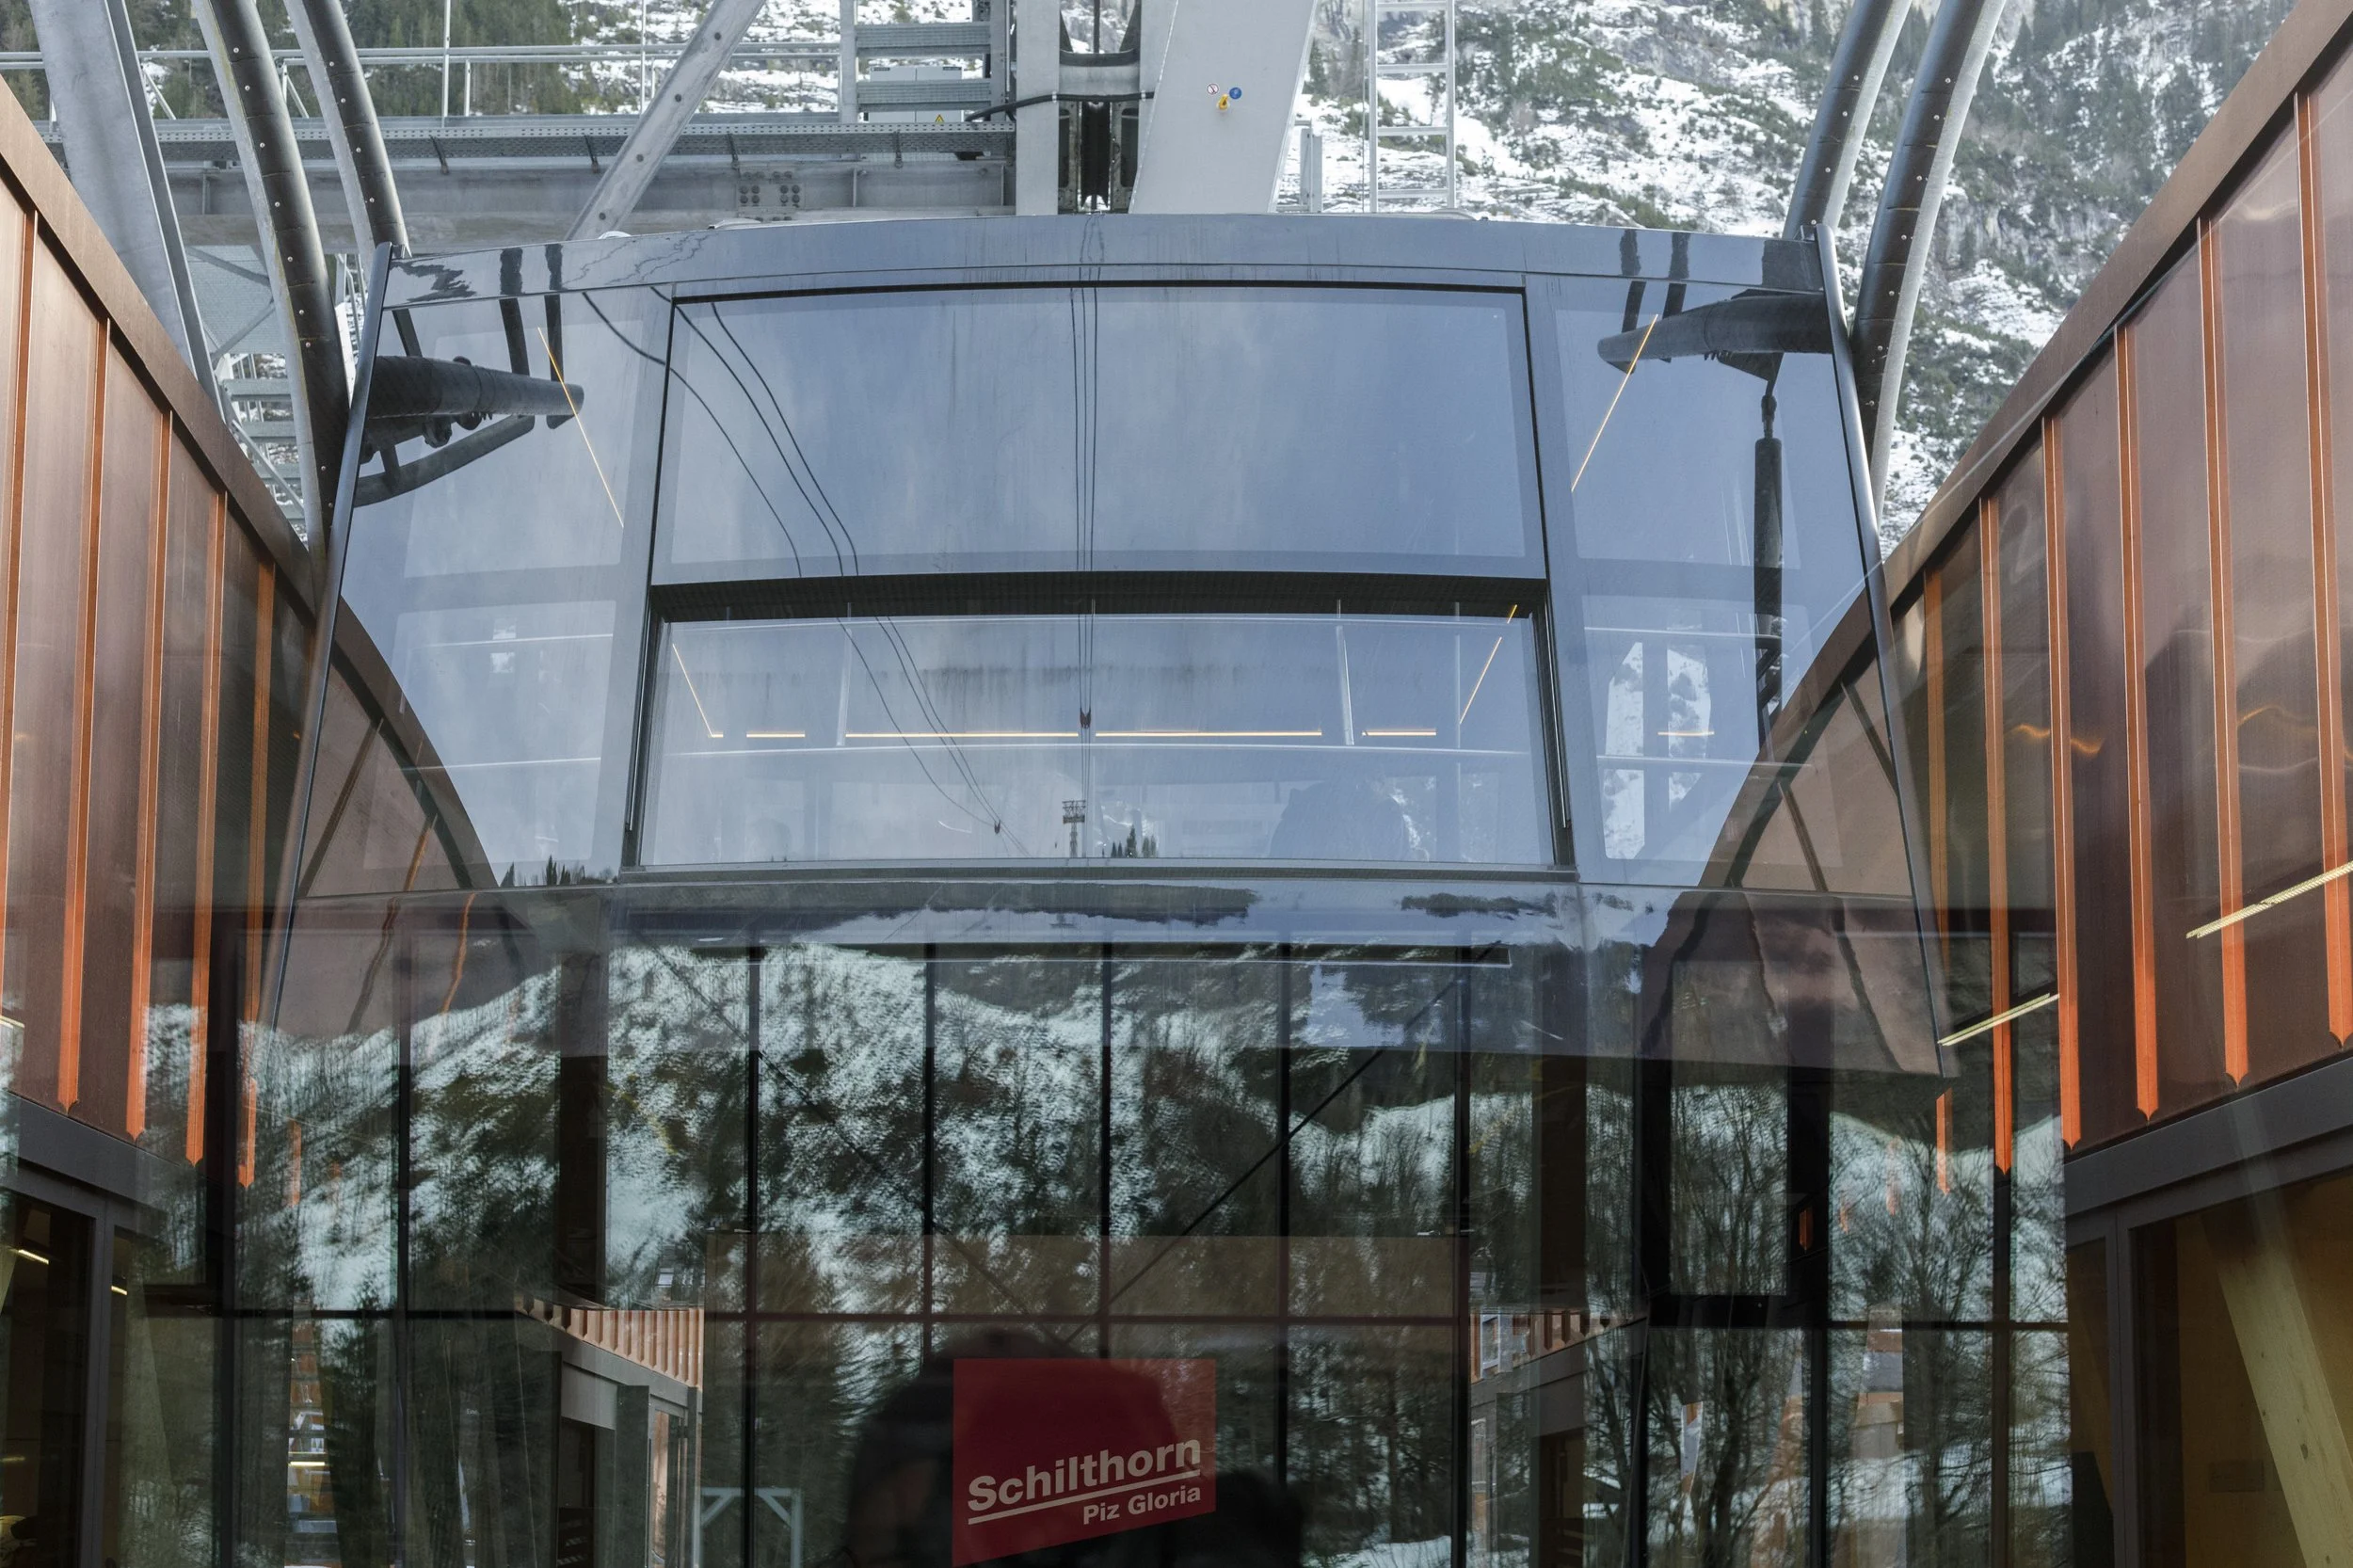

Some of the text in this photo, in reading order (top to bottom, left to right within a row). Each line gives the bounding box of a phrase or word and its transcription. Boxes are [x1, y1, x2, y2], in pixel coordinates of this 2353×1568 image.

[968, 1439, 1201, 1512] Schilthorn
[1083, 1485, 1201, 1525] Piz Gloria
